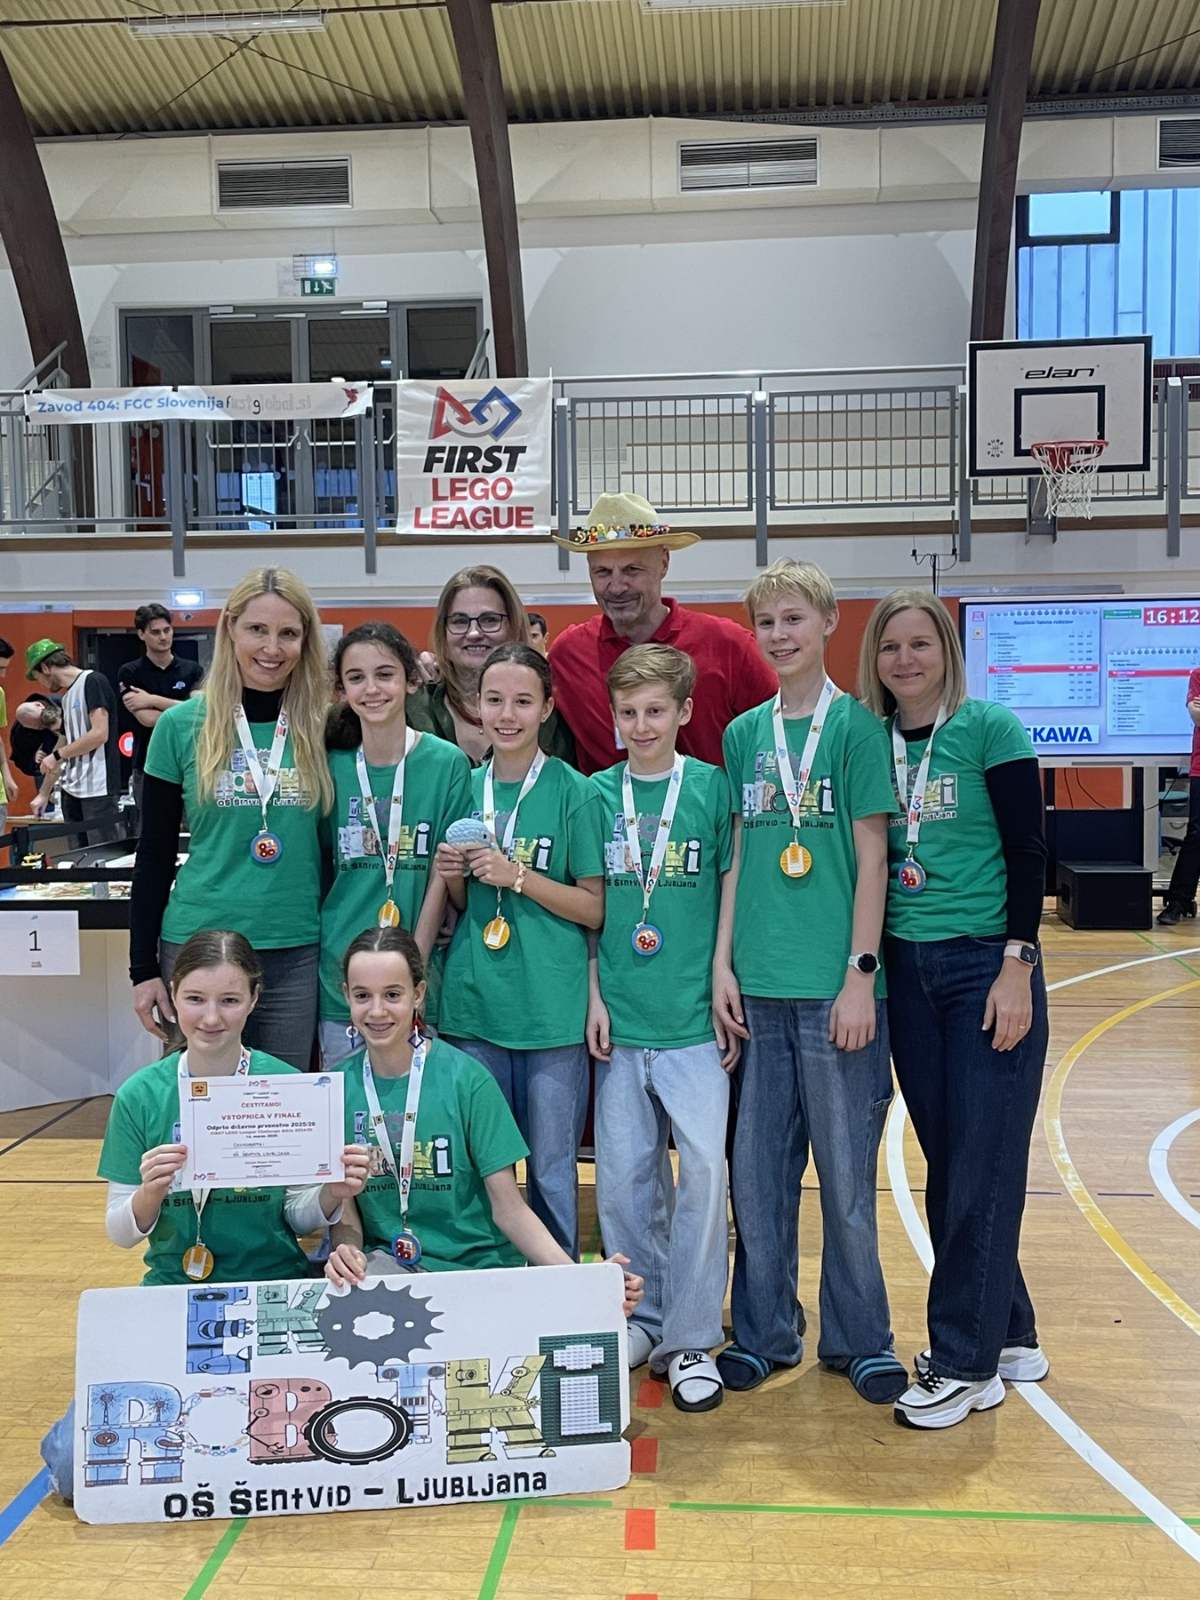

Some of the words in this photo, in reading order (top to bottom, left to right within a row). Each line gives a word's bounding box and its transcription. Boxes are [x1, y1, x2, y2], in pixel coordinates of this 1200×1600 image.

[1025, 366, 1095, 379] elan
[37, 400, 82, 414] Zavod
[87, 399, 120, 412] 404:
[124, 398, 152, 411] FGC
[156, 395, 224, 413] Slovenija
[423, 446, 527, 473] FIRST
[432, 477, 513, 502] LEGO
[413, 506, 535, 530] LEAGUE
[1146, 608, 1200, 624] 16:12
[29, 930, 42, 951] 1
[683, 1352, 704, 1363] NIKE
[164, 1481, 215, 1519] OŠ
